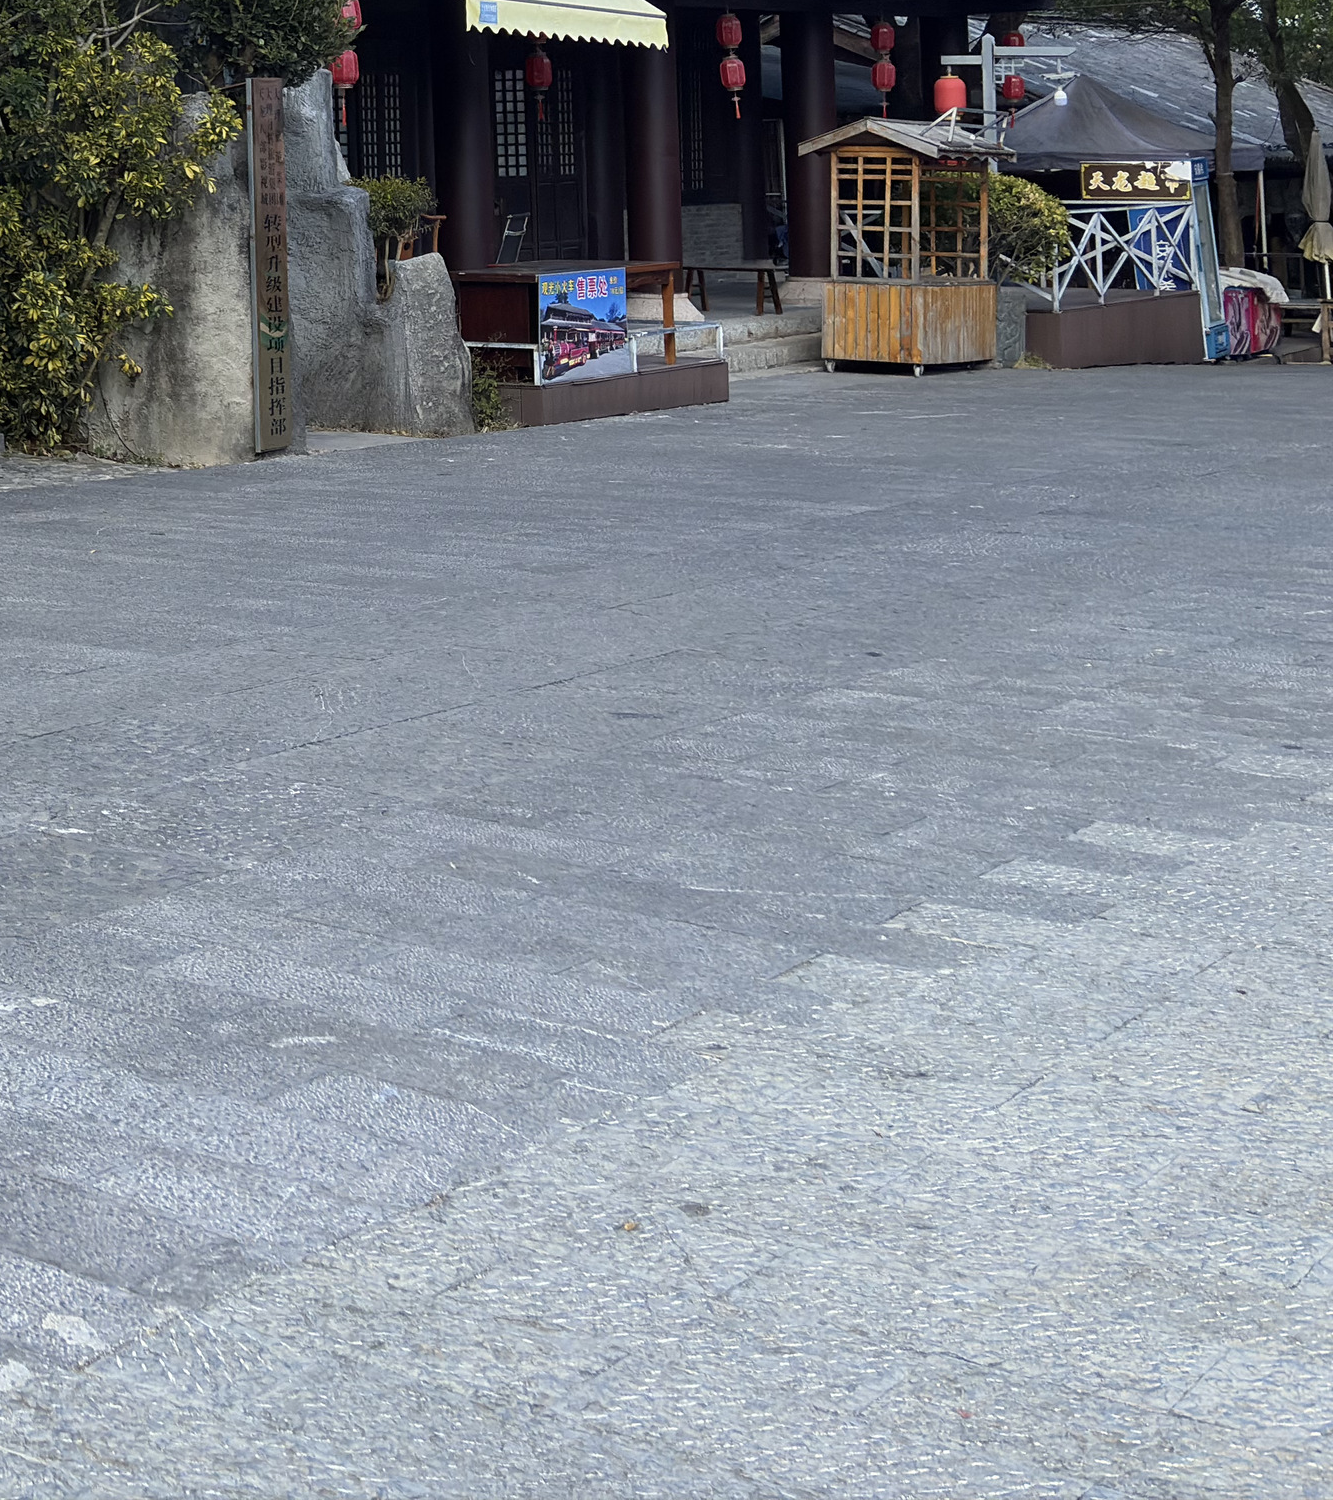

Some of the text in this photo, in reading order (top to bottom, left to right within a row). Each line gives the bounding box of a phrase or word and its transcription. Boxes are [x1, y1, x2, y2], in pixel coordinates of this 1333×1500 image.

[1088, 170, 1180, 194] 天龙超市
[541, 279, 575, 296] 观光小火车
[576, 275, 609, 301] 售票处
[264, 213, 287, 437] 转型升级建设项目指挥部
